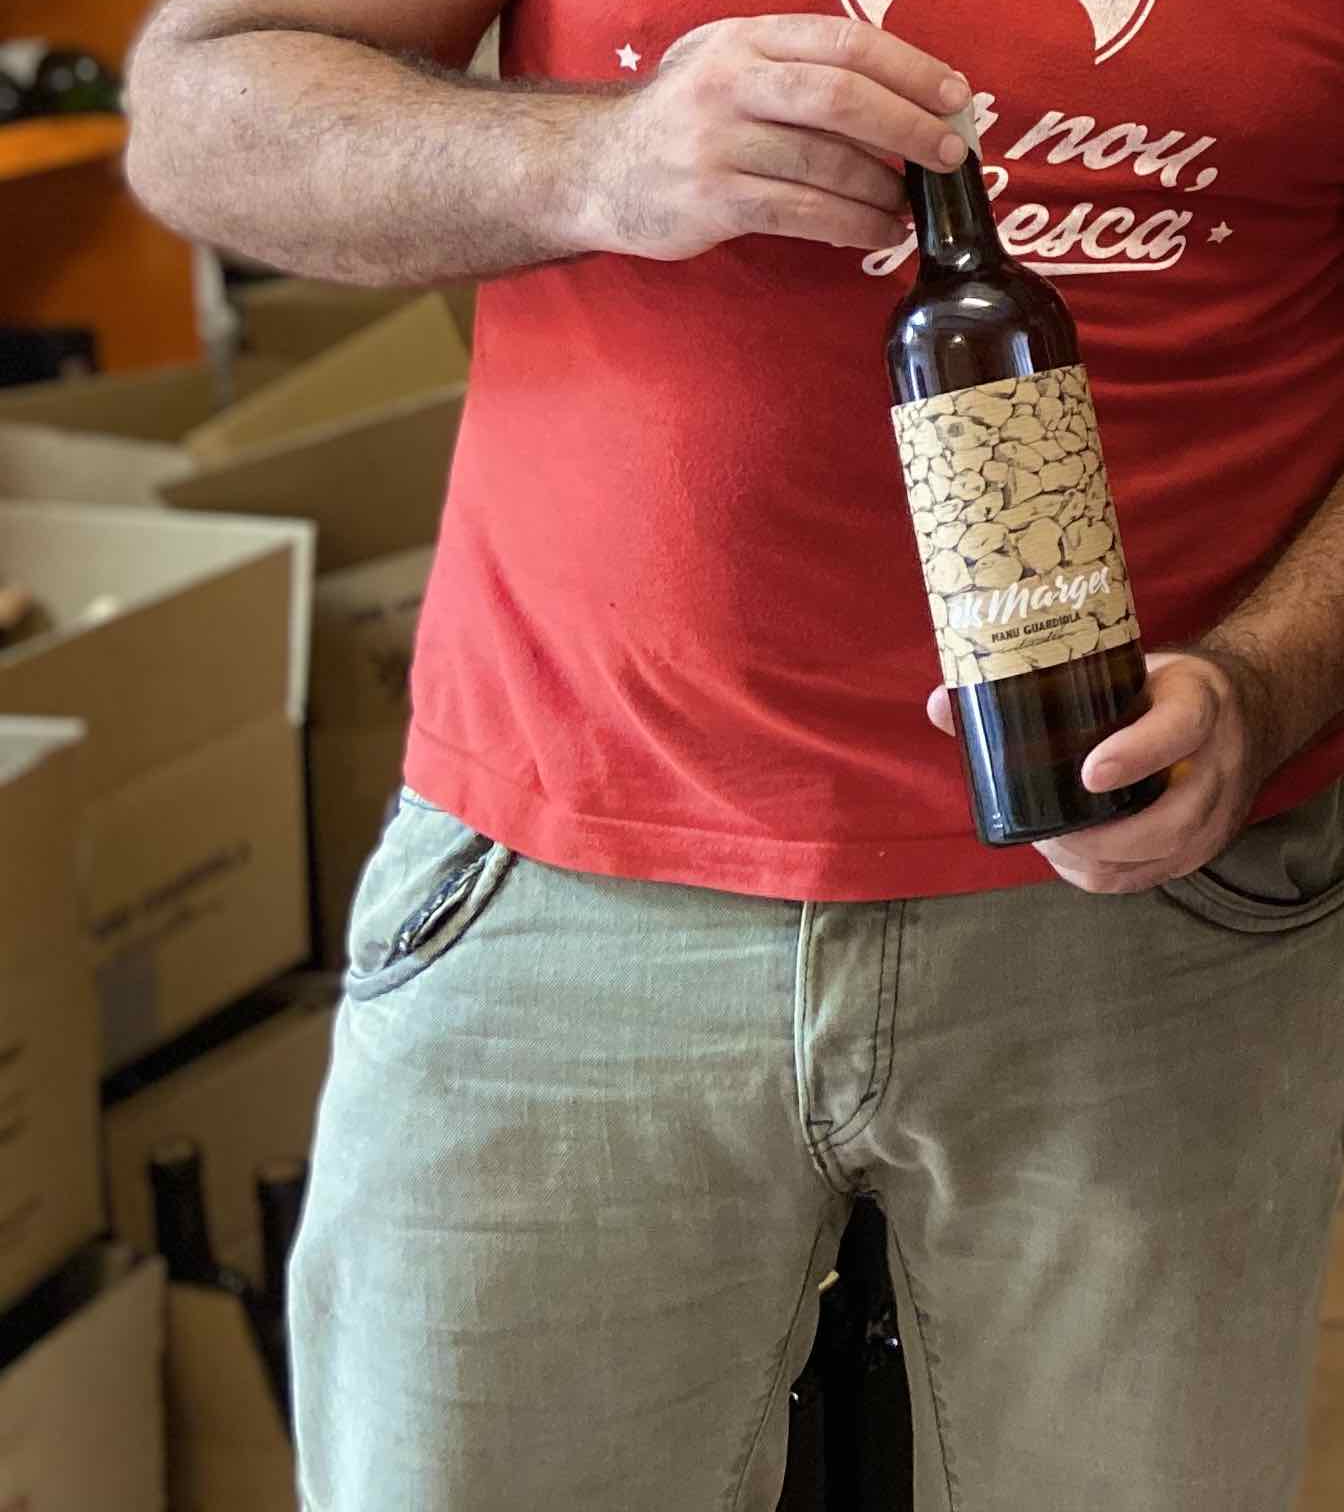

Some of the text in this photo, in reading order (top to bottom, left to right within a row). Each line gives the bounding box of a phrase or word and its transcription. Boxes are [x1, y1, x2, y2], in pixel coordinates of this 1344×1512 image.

[1004, 111, 1218, 192] nou,
[992, 628, 1021, 643] MANU
[1024, 612, 1081, 635] GUARDIOLA
